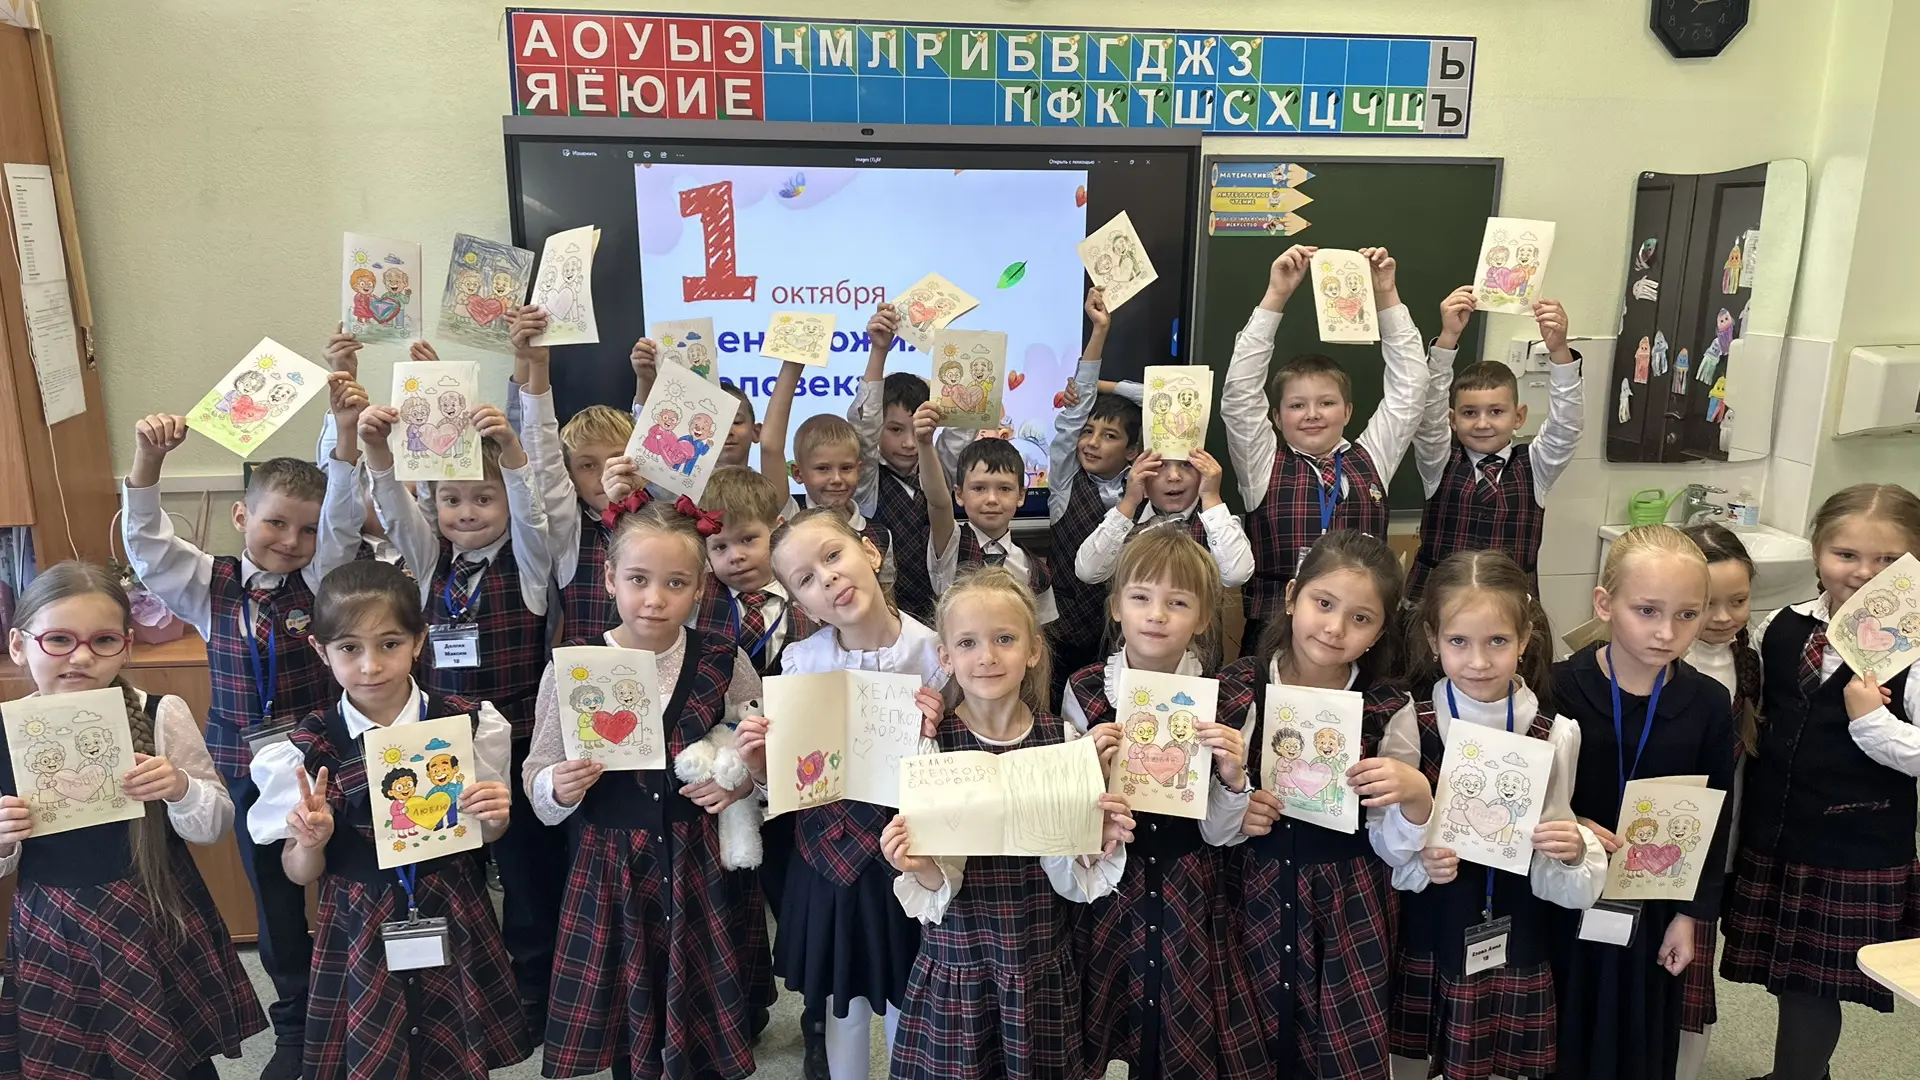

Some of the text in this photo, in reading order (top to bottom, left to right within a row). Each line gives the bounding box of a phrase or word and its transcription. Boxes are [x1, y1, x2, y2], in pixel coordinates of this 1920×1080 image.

[522, 20, 1465, 81] А О У Ы Э Н М Л Р Й Б В Г Д Ж З Ь
[526, 68, 1462, 131] Я Ё Ю И Е П Ф К Т Ш С Х Ц Ч Щ Ъ
[679, 181, 758, 303] 1
[772, 279, 886, 310] октября
[717, 331, 765, 353] ен
[413, 804, 448, 816] ЛЮБЛЮ
